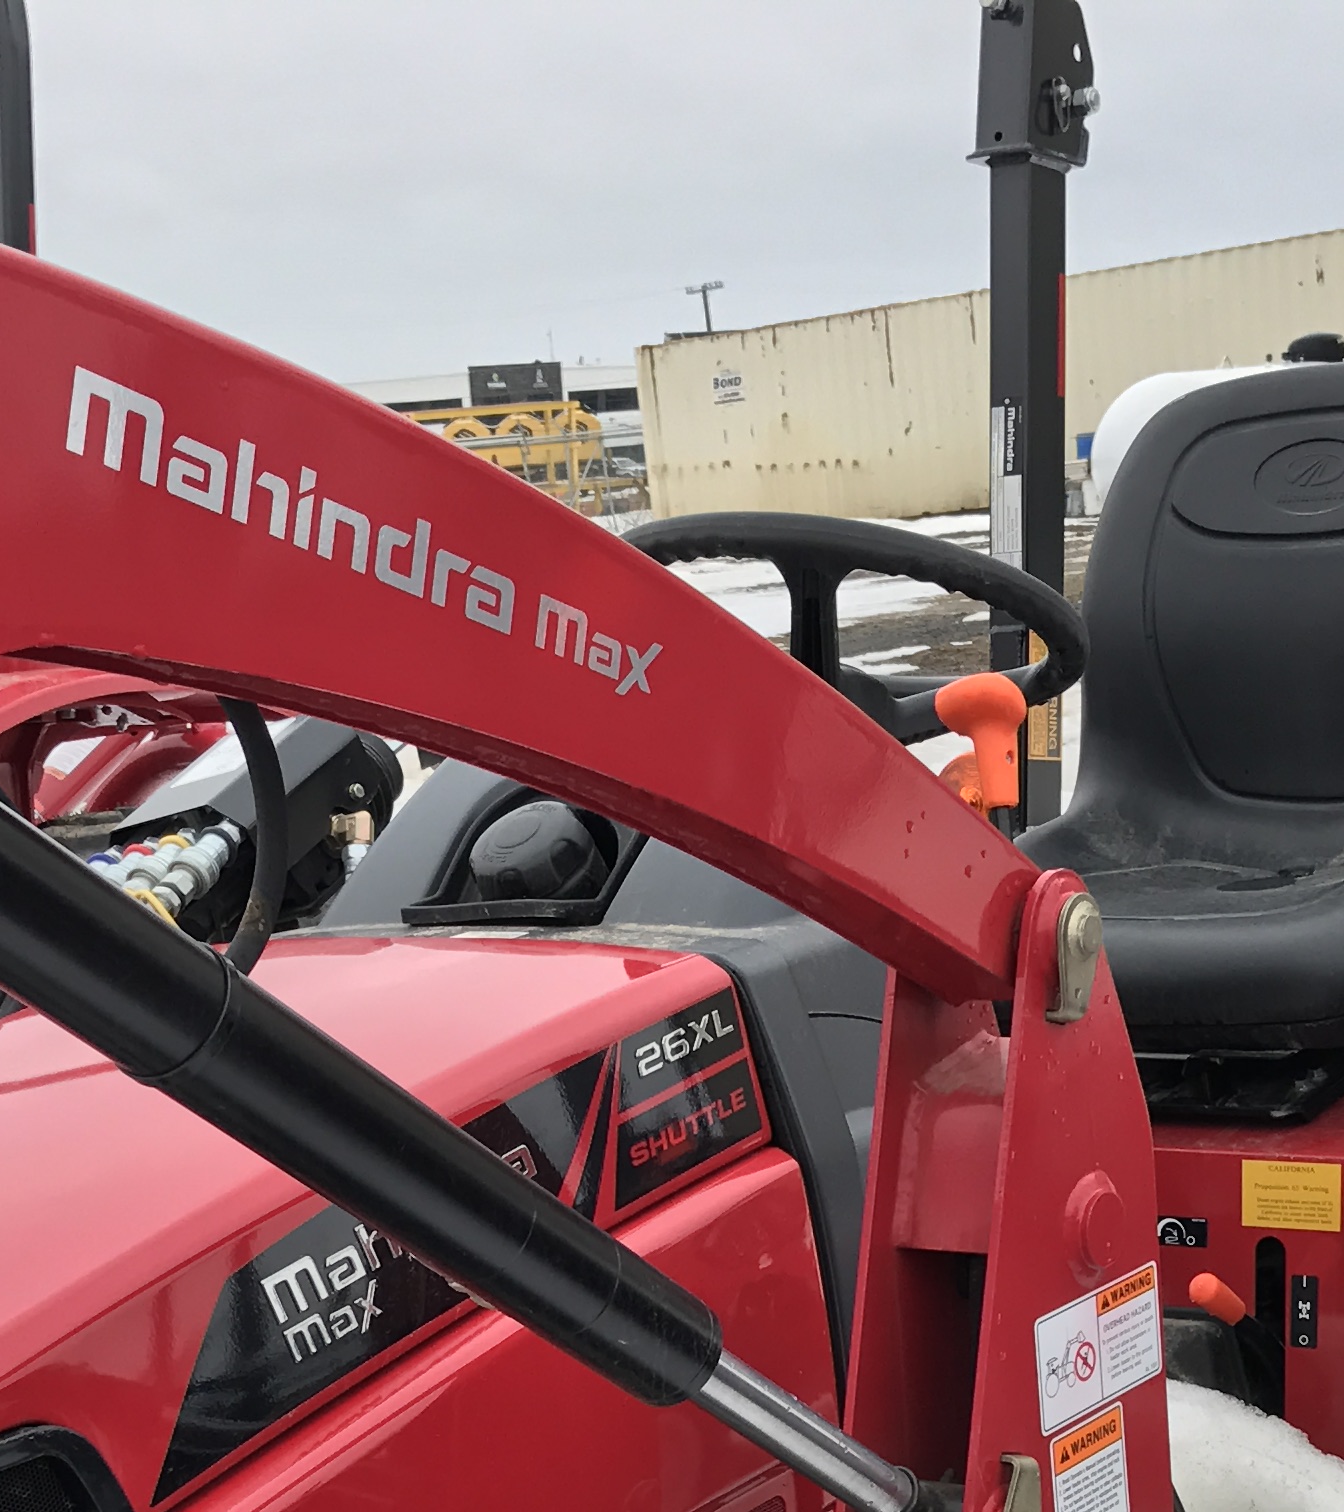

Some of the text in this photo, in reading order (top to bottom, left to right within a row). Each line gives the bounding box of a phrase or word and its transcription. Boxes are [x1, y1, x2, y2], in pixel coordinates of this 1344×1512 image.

[713, 376, 742, 390] BOND
[1006, 407, 1015, 472] Mahindra
[65, 364, 664, 697] Mahindra Max
[635, 1008, 735, 1077] 26XL
[630, 1086, 748, 1167] SHUTTLE
[1268, 1165, 1316, 1174] CALIFORNIA
[1110, 1272, 1152, 1303] WARNING
[283, 1278, 382, 1363] Max
[1070, 1418, 1116, 1457] WARNING
